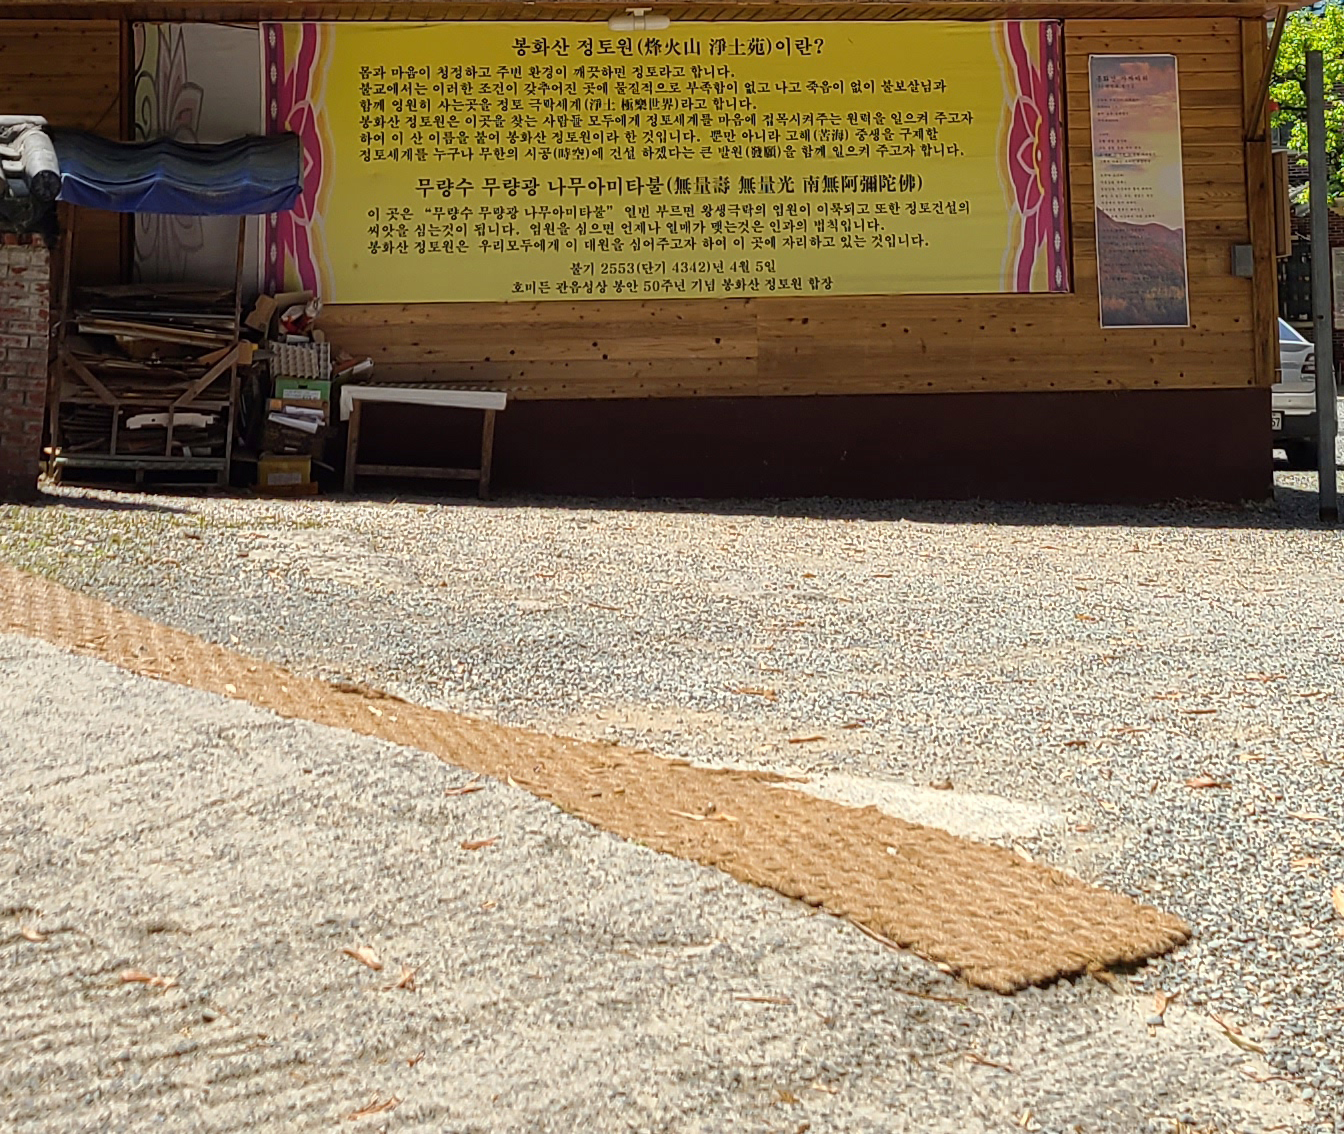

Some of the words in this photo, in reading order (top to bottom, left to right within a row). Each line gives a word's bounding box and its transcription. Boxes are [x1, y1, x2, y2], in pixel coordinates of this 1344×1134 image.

[511, 36, 571, 57] 봉화산
[358, 65, 387, 80] 몸과
[391, 65, 431, 81] 마음이
[436, 64, 492, 80] 청정하고
[495, 65, 523, 80] 주변
[527, 64, 567, 80] 환경이
[572, 64, 627, 80] 깨끗하면
[631, 64, 686, 80] 정토라고
[689, 64, 735, 79] 합니다.
[358, 81, 429, 97] 불교에서는
[432, 81, 474, 97] 이러한
[477, 81, 518, 96] 조건이
[523, 81, 578, 96] 갖추어진
[582, 81, 608, 96] 곳에
[613, 80, 682, 96] 물질적으로
[685, 80, 738, 96] 부족함이
[744, 80, 771, 95] 없고
[774, 80, 802, 95] 나고
[805, 79, 844, 95] 죽음이
[850, 79, 875, 94] 없이
[880, 78, 947, 94] 불보살님과
[359, 98, 385, 113] 함께
[391, 97, 431, 113] 영원히
[437, 97, 493, 113] 사는곳을
[496, 97, 525, 113] 정토
[711, 96, 757, 112] 합니다.
[358, 114, 401, 130] 봉화산
[404, 114, 461, 129] 정토원은
[464, 113, 507, 129] 이곳을
[510, 113, 539, 129] 찾는
[542, 113, 584, 129] 사람들
[587, 113, 640, 129] 모두에게
[645, 112, 714, 128] 정토세계를
[717, 112, 757, 128] 마음에
[890, 111, 928, 126] 일으켜
[934, 110, 974, 126] 주고자
[359, 130, 385, 146] 하여
[391, 130, 404, 146] 이
[410, 130, 424, 146] 산
[428, 130, 470, 146] 이름을
[505, 129, 548, 145] 봉화산
[551, 129, 620, 145] 정토원이라
[623, 129, 638, 144] 한
[642, 128, 701, 145] 것입니다.
[709, 128, 737, 143] 뿐만
[741, 128, 782, 144] 아니라
[854, 127, 895, 142] 중생을
[898, 126, 939, 142] 구제할
[359, 147, 429, 163] 정토세계를
[432, 146, 475, 162] 누구나
[478, 146, 518, 162] 무한의
[609, 145, 636, 161] 건설
[641, 145, 696, 161] 하겠다는
[699, 145, 713, 160] 큰
[800, 144, 826, 159] 함께
[875, 142, 916, 158] 주고자
[919, 142, 964, 158] 합니다.
[414, 177, 475, 199] 무량수
[481, 176, 541, 198] 무량광
[367, 206, 380, 222] 이
[385, 207, 414, 222] 곳은
[477, 205, 520, 221] 무량광
[655, 203, 696, 219] 부르면
[700, 202, 766, 218] 왕생극락의
[874, 201, 901, 216] 또한
[904, 200, 970, 216] 정토건설의
[367, 223, 409, 239] 씨앗을
[413, 222, 467, 238] 심는것이
[473, 221, 520, 237] 됩니다.
[575, 221, 615, 237] 심으면
[620, 220, 662, 236] 언제나
[665, 219, 707, 235] 열매가
[769, 218, 807, 234] 인과의
[813, 217, 885, 233] 법칙입니다.
[367, 239, 409, 255] 봉화산
[413, 239, 470, 255] 정토원은
[478, 238, 560, 254] 우리모두에게
[565, 237, 578, 253] 이
[584, 237, 625, 253] 대원을
[629, 236, 698, 252] 심어주고자
[701, 235, 727, 251] 하여
[732, 235, 745, 251] 이
[750, 235, 776, 251] 곳에
[782, 234, 836, 250] 자리하고
[840, 234, 867, 249] 있는
[871, 233, 929, 249] 것입니다.
[569, 261, 595, 277] 불기
[600, 260, 666, 275] 2553(단기
[671, 259, 725, 274] 4342)년
[729, 259, 750, 274] 4월
[755, 258, 777, 274] 5일
[511, 280, 551, 295] 호미든
[555, 279, 608, 294] 관음성상
[643, 278, 686, 293] 50주년
[691, 278, 715, 293] 기념
[721, 277, 760, 292] 봉화산
[764, 276, 803, 292] 정토원
[807, 275, 834, 291] 합장
